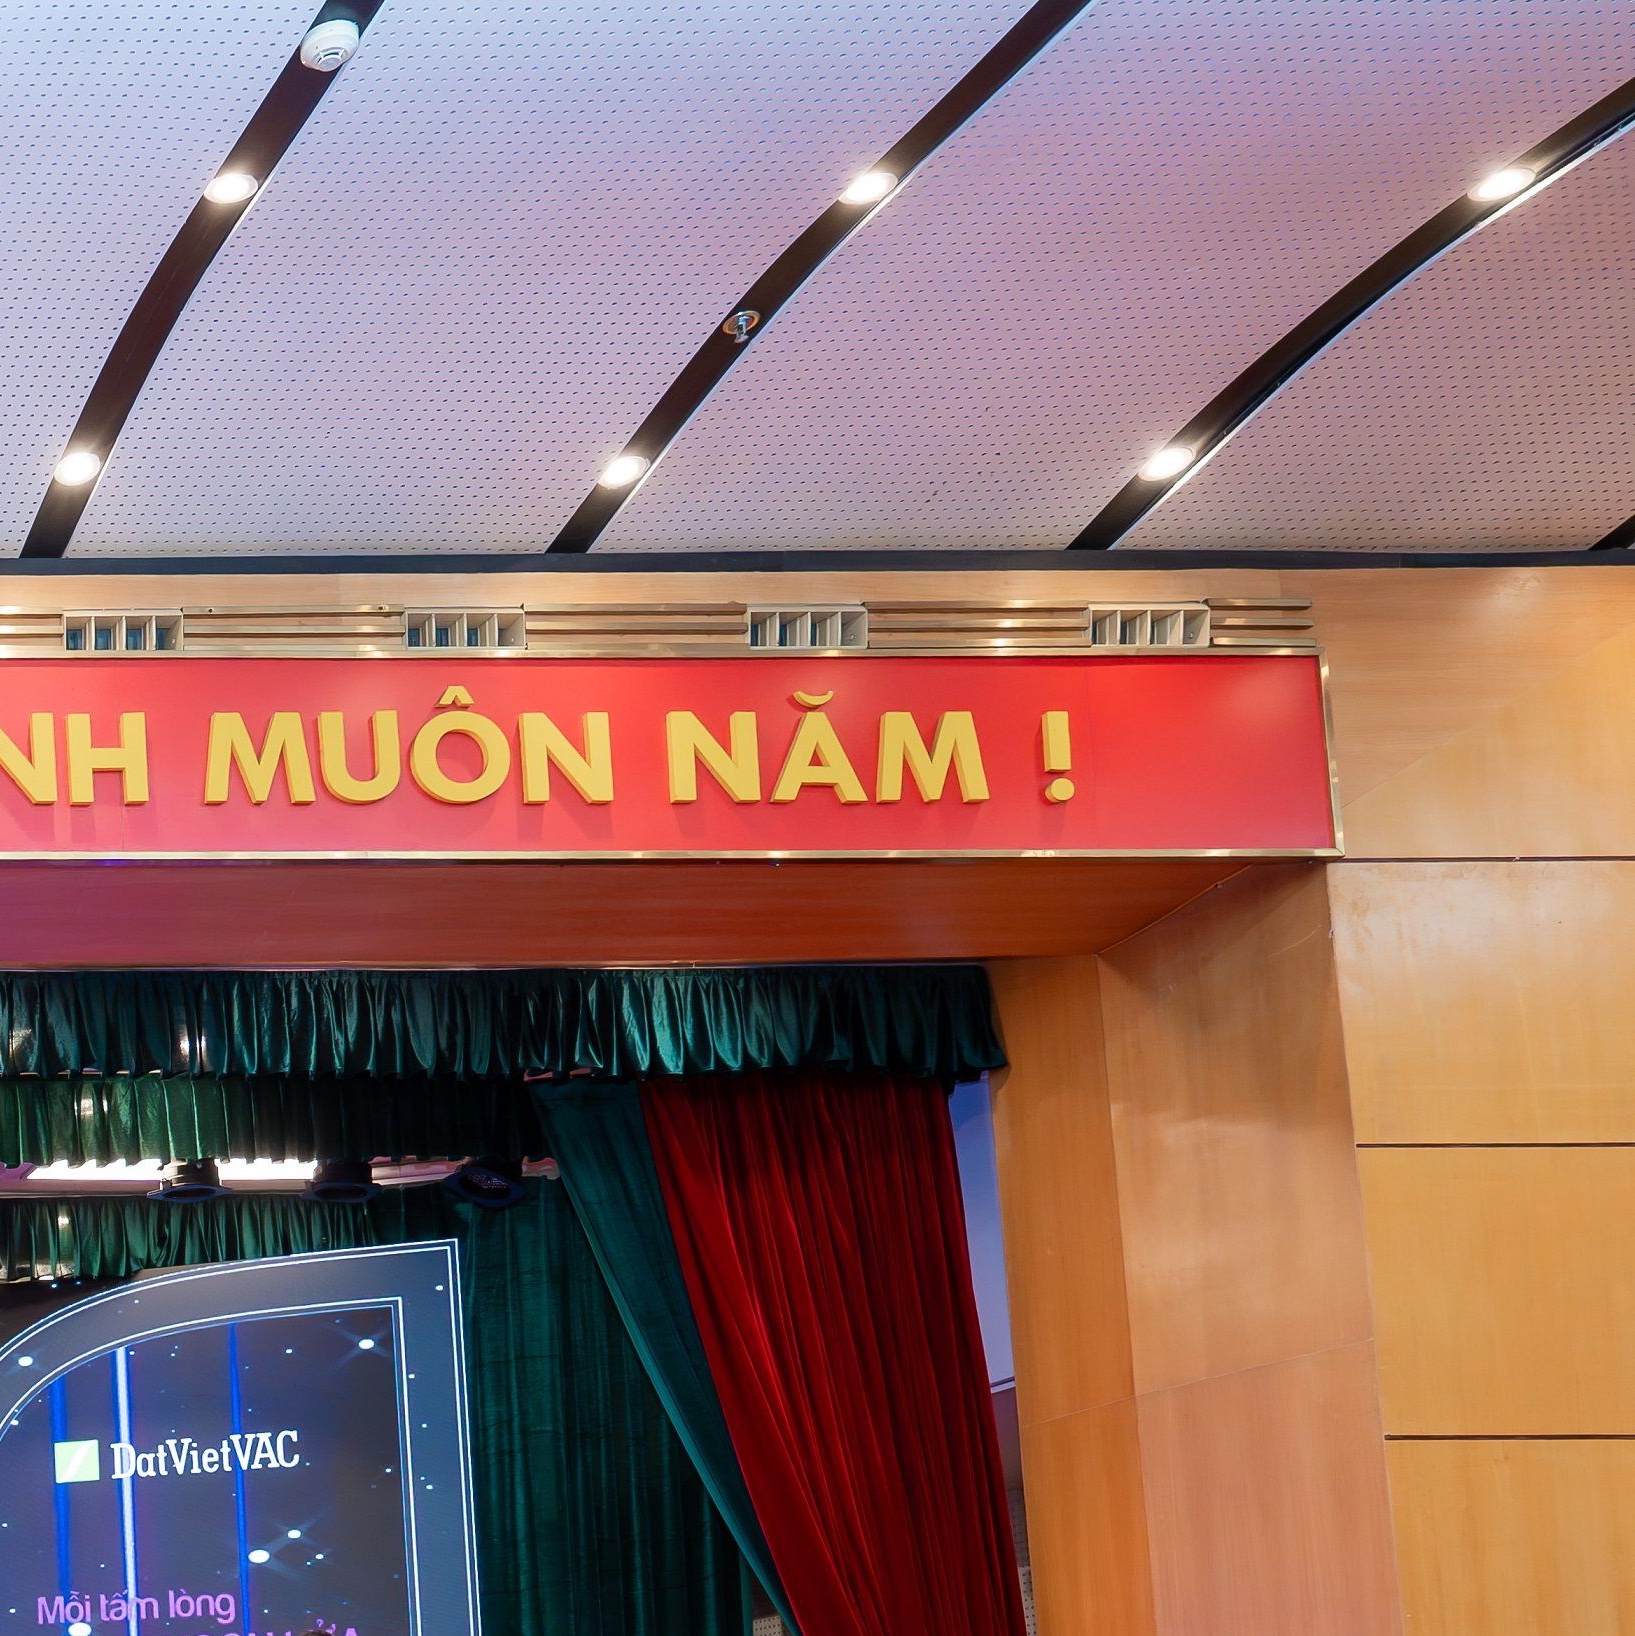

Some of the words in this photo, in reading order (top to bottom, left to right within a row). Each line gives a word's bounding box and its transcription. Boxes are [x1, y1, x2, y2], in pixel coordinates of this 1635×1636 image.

[203, 685, 616, 806] MUÔN
[664, 689, 991, 806] NĂM
[1041, 710, 1076, 802] !
[110, 1429, 300, 1480] DatVietVAC
[37, 1590, 92, 1626] Mỗi
[99, 1588, 159, 1622] tấm
[168, 1589, 236, 1625] lòng
